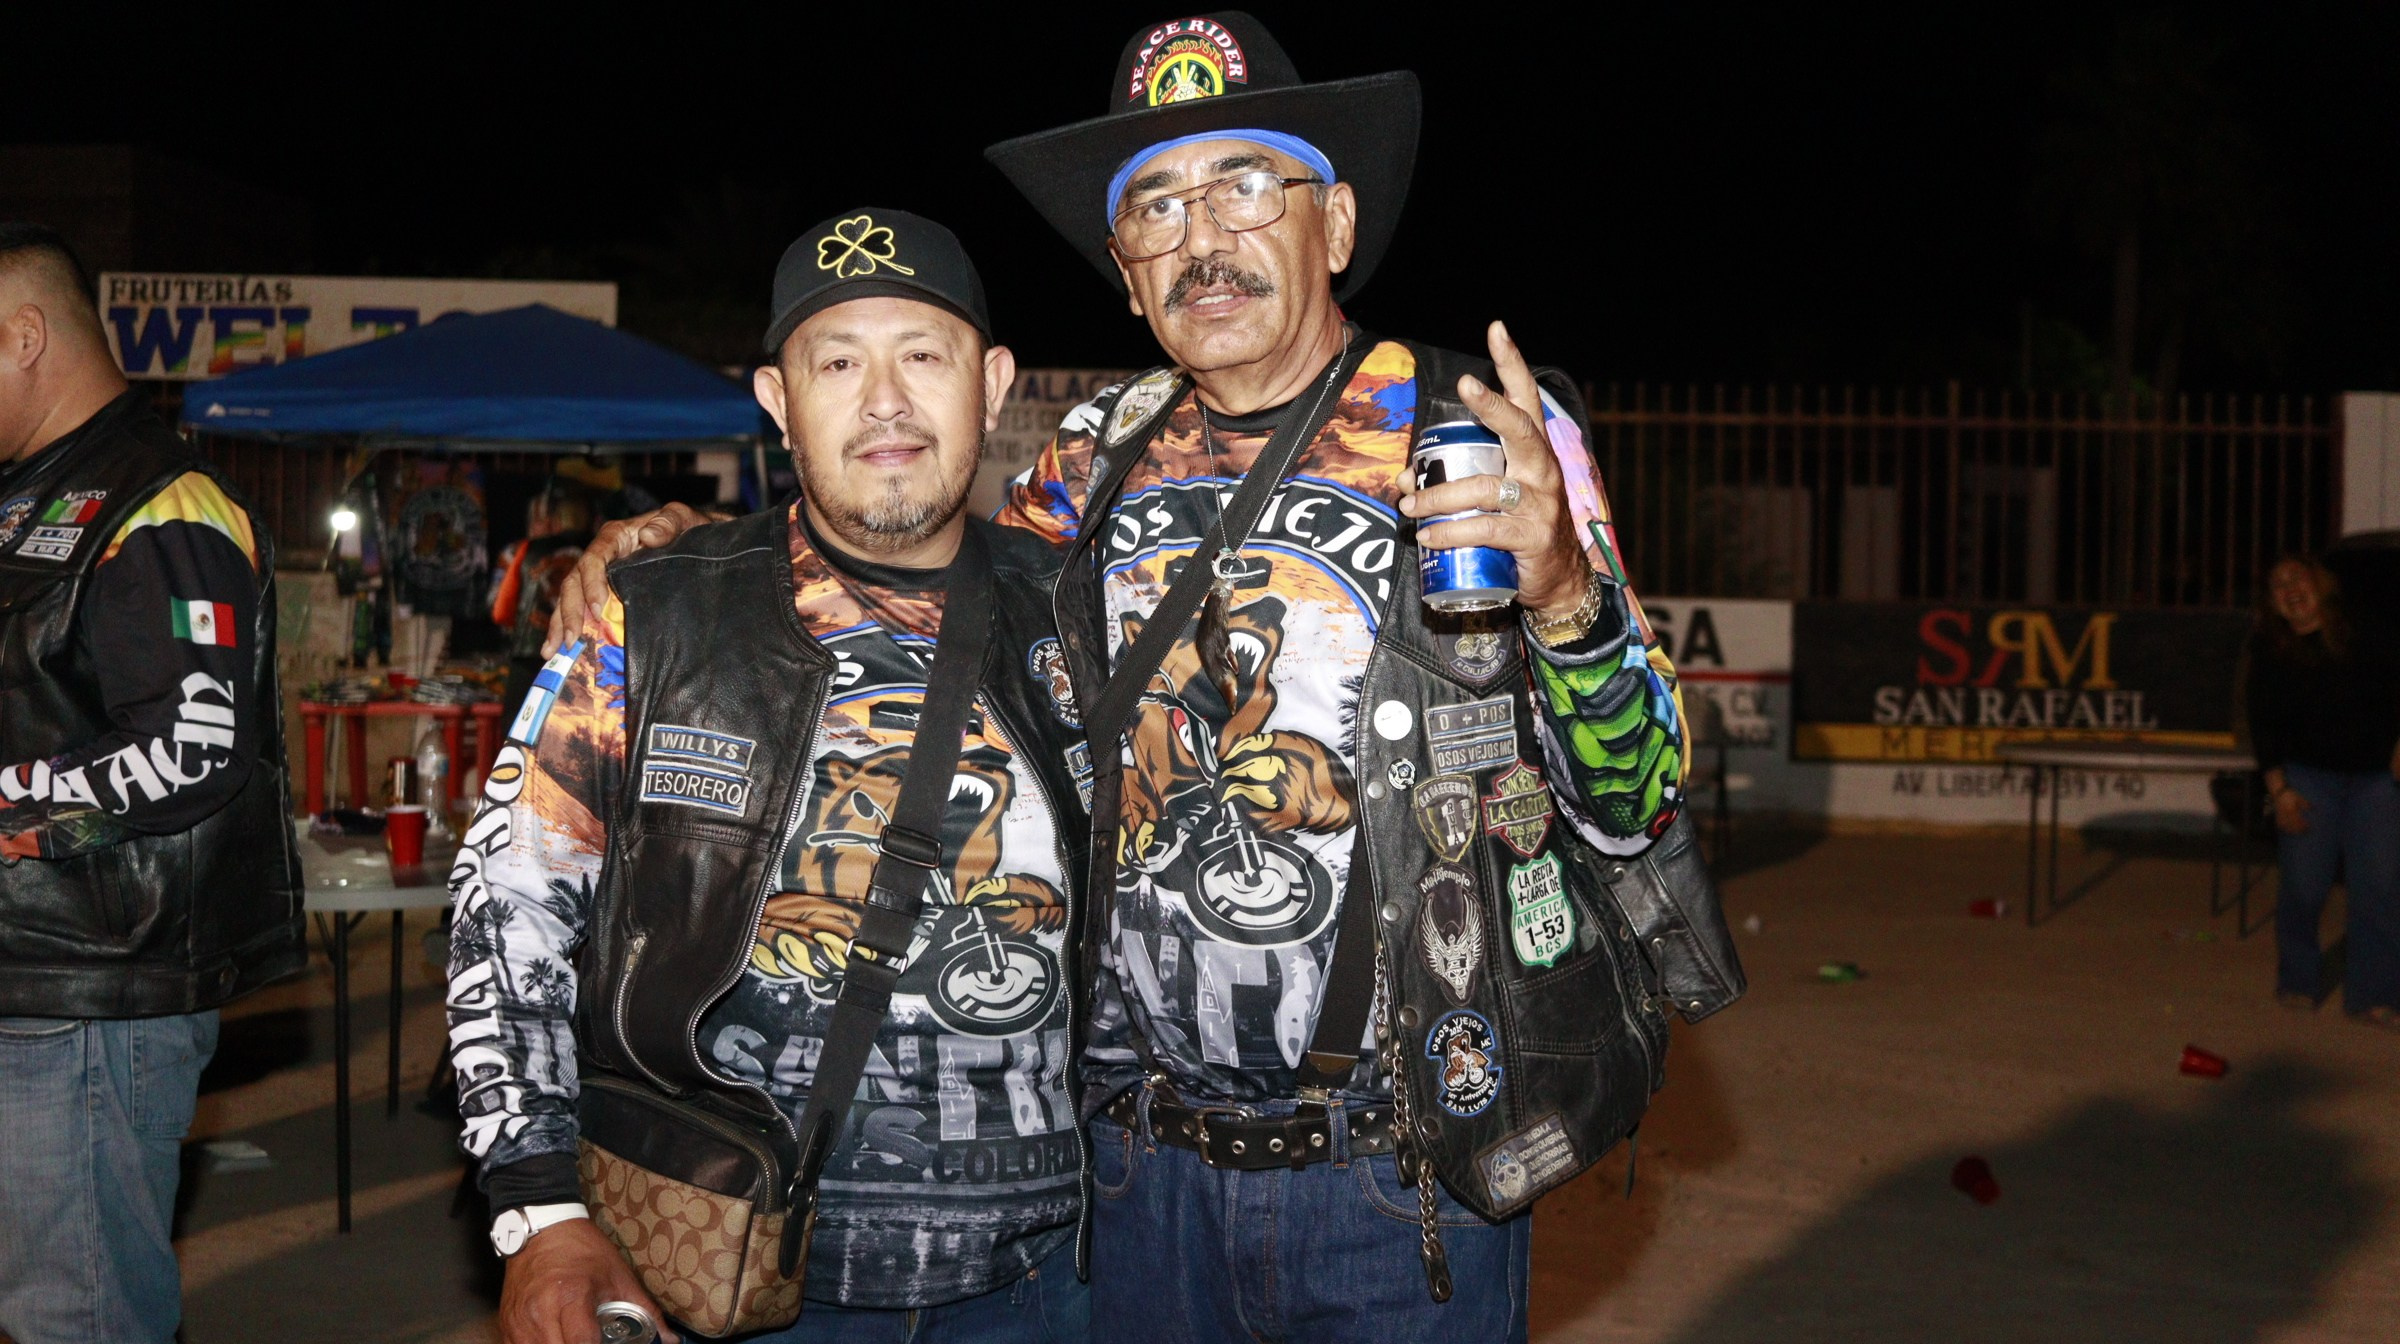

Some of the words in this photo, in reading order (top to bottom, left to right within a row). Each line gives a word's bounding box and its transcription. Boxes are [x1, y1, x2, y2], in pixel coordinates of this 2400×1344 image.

[1131, 21, 1180, 95] PEACE
[1188, 19, 1243, 77] RIDER
[108, 275, 293, 302] FRUTERÍAS
[1479, 704, 1506, 724] POS
[1872, 685, 1967, 726] SAN
[1977, 687, 2159, 730] RAFAEL
[661, 732, 740, 760] WILLYS
[1437, 749, 1467, 768] OSOS
[646, 771, 742, 805] TESORERO
[1489, 803, 1510, 825] LA
[1518, 872, 1531, 889] LA
[1532, 861, 1554, 885] RECTA
[1549, 876, 1561, 893] DE
[1517, 898, 1566, 929] AMERICA
[1525, 914, 1565, 947] 1-53
[1432, 1024, 1451, 1053] OSOS
[1452, 1016, 1483, 1033] VIEJOS
[1480, 1037, 1492, 1049] MC
[1446, 1099, 1466, 1114] SAN
